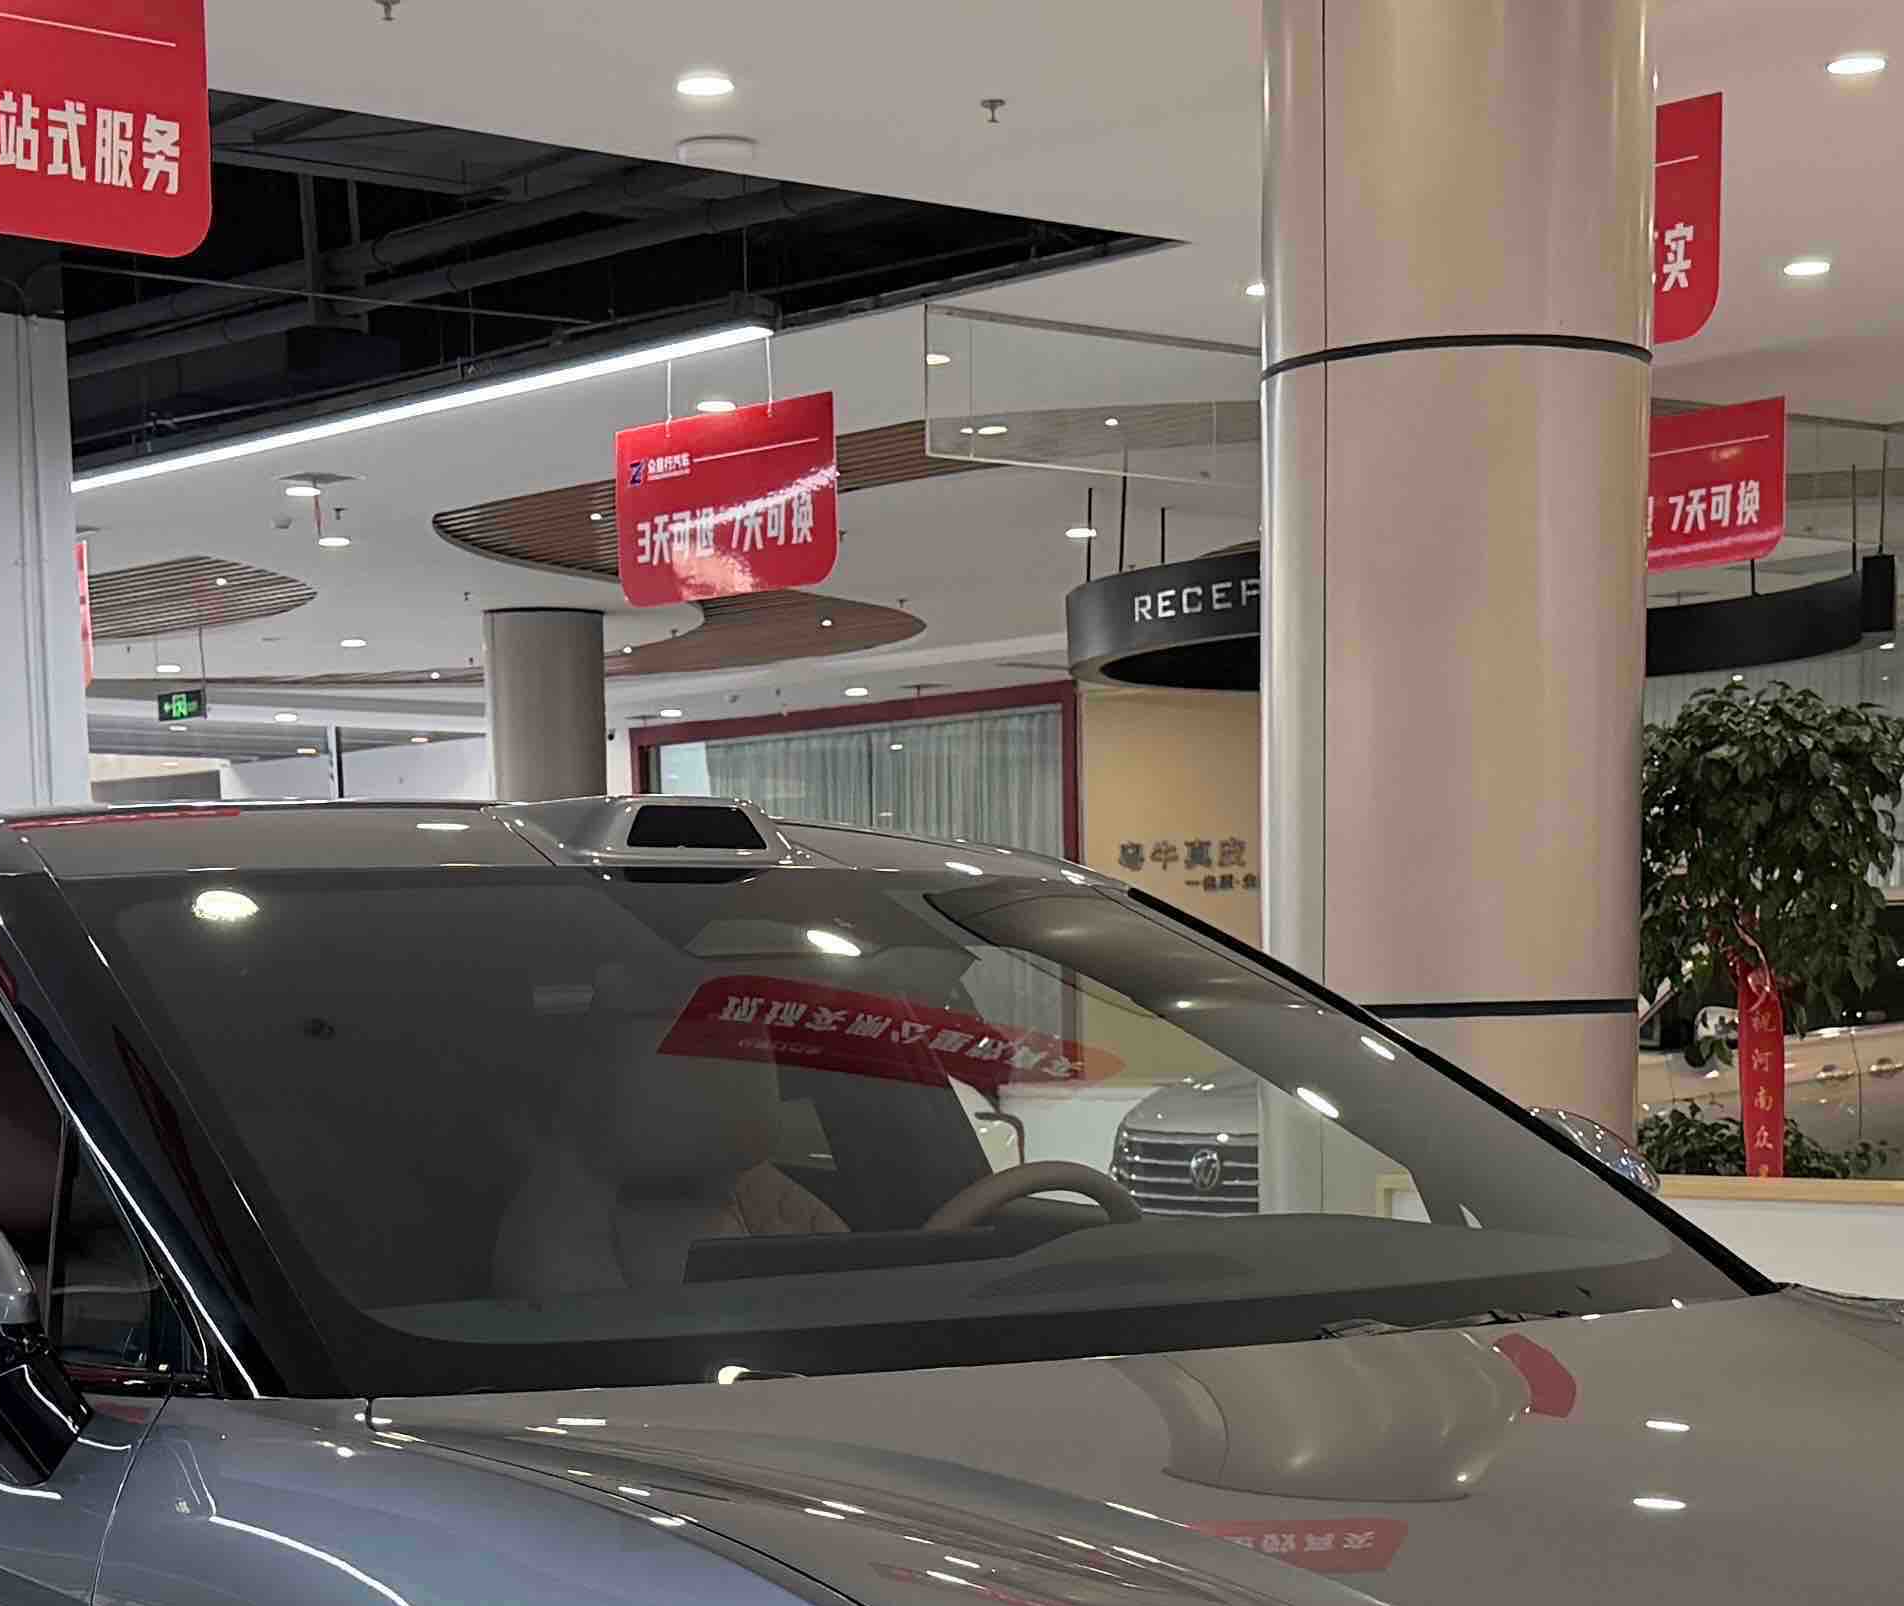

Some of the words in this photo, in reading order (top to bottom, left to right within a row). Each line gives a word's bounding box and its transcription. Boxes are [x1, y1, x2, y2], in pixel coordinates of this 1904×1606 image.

[1654, 222, 1694, 292] 实
[1668, 480, 1760, 534] 7天可换
